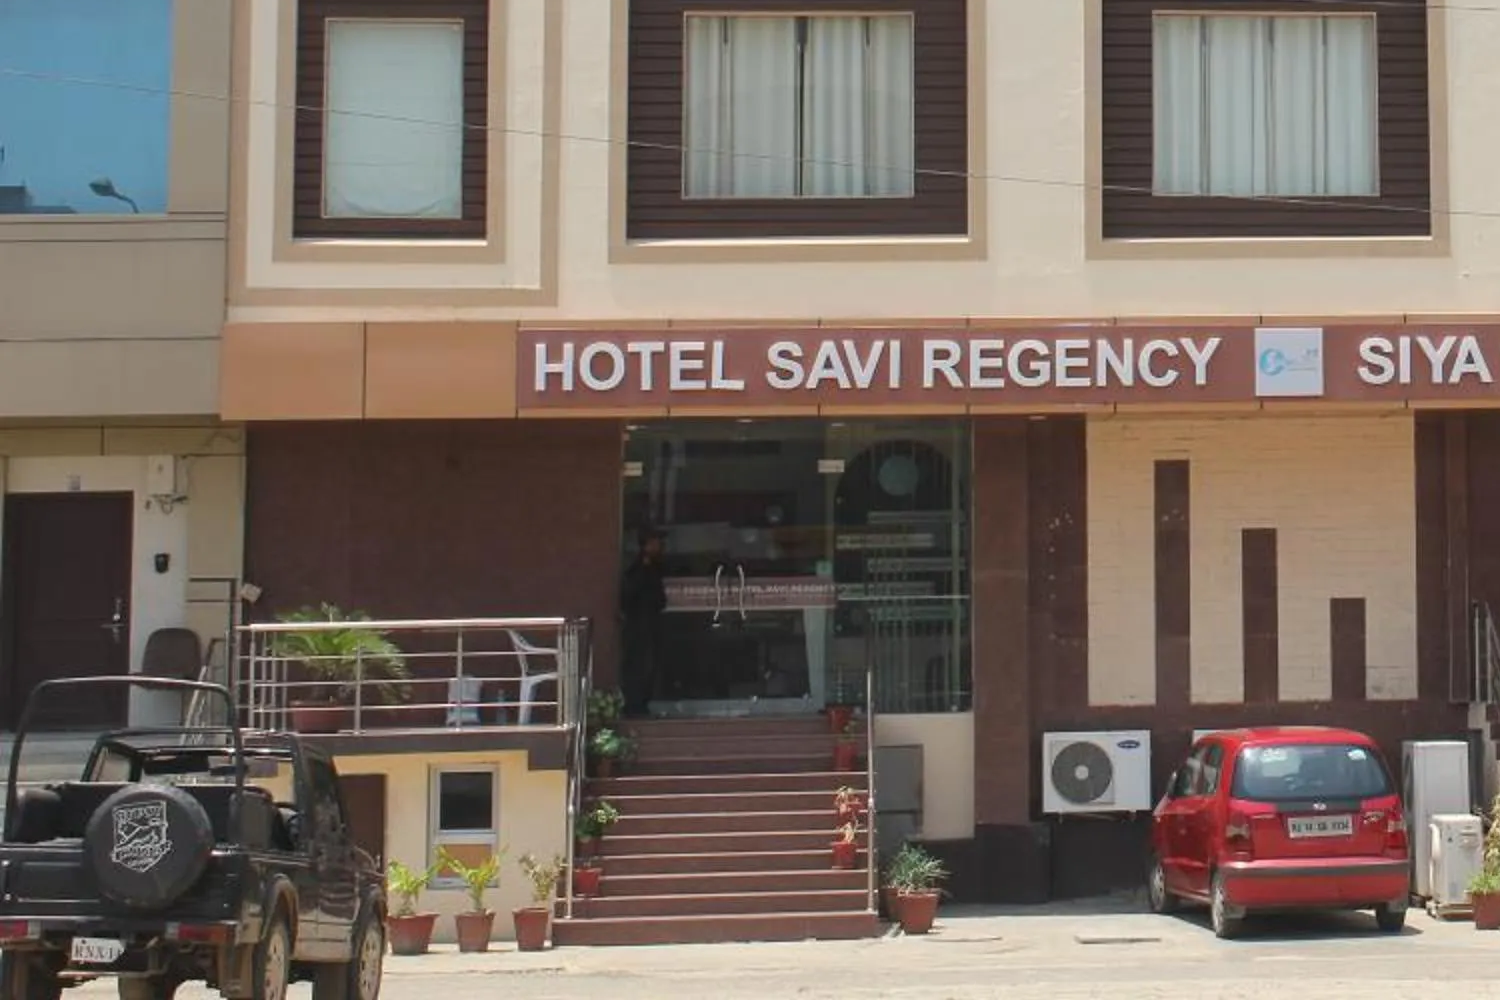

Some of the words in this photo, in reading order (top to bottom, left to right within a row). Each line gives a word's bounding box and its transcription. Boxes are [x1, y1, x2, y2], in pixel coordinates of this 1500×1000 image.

[534, 341, 744, 391] HOTEL
[766, 340, 900, 389] SAVI
[923, 337, 1222, 388] REGENCY
[1357, 335, 1494, 384] SIYA
